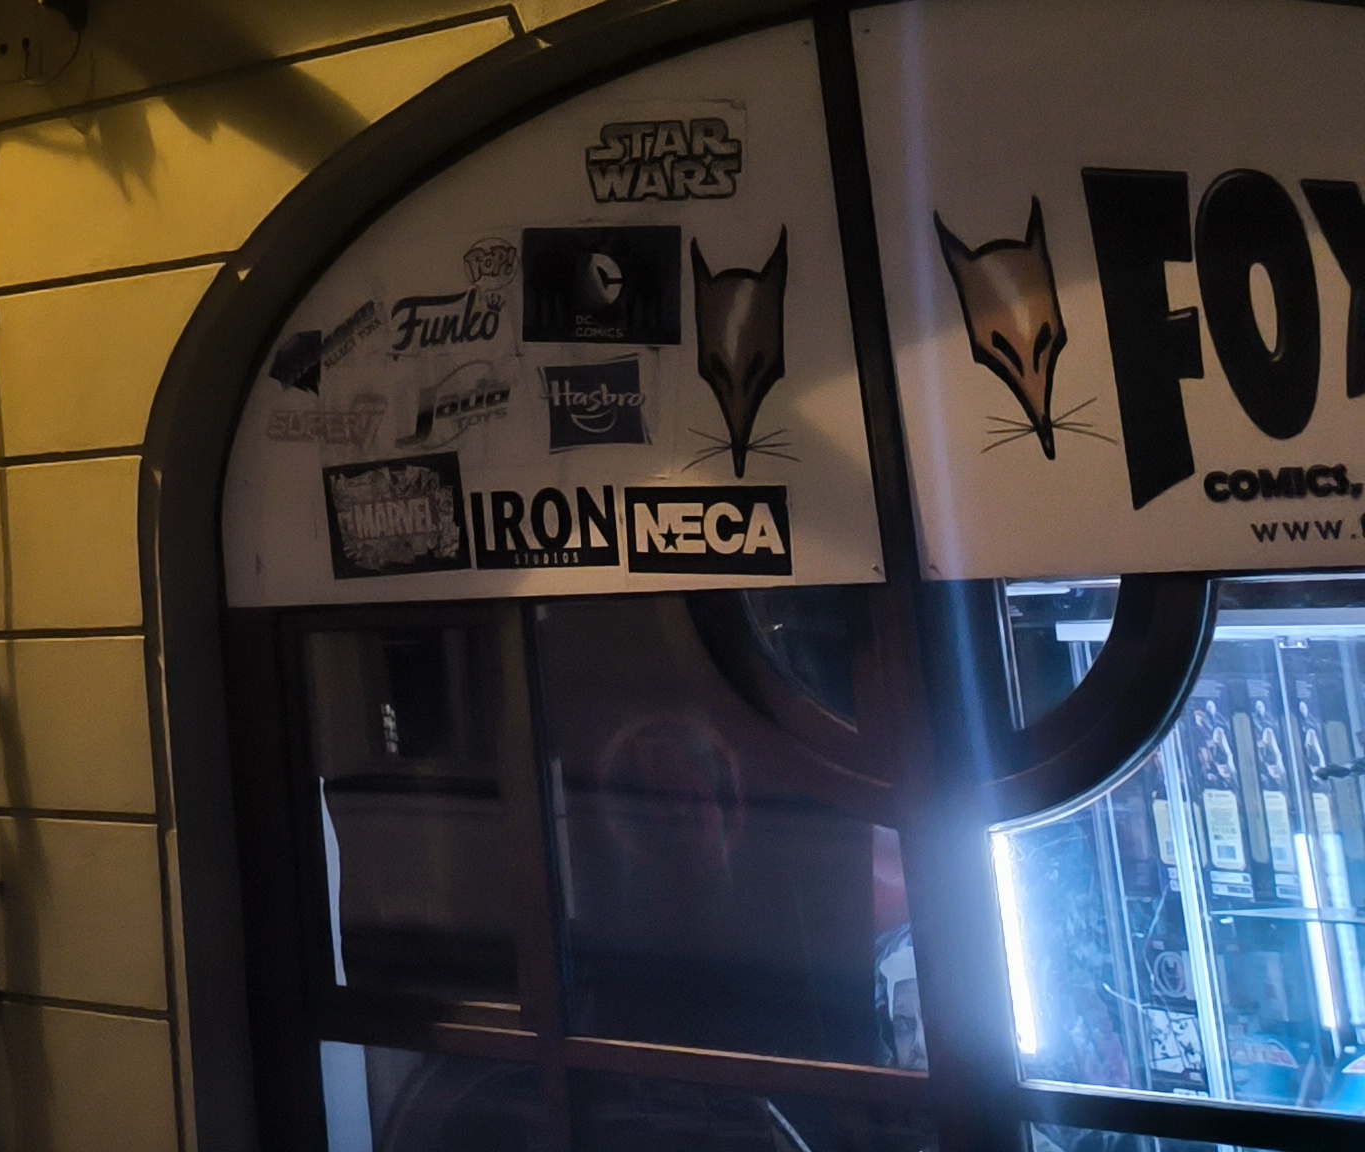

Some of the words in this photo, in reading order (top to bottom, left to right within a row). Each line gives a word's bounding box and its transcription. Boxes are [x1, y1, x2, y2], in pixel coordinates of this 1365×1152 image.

[585, 118, 742, 163] STAR
[586, 158, 742, 202] WARS
[463, 245, 517, 283] POP!
[391, 288, 501, 350] Funko
[575, 327, 624, 339] COMICS
[545, 380, 645, 411] Hasbro
[1204, 464, 1364, 501] COMICS,
[353, 497, 437, 539] MARVEL
[471, 485, 619, 551] IRON
[634, 501, 786, 555] NECA
[1251, 514, 1365, 542] www.
[514, 551, 580, 566] STUDIOS
